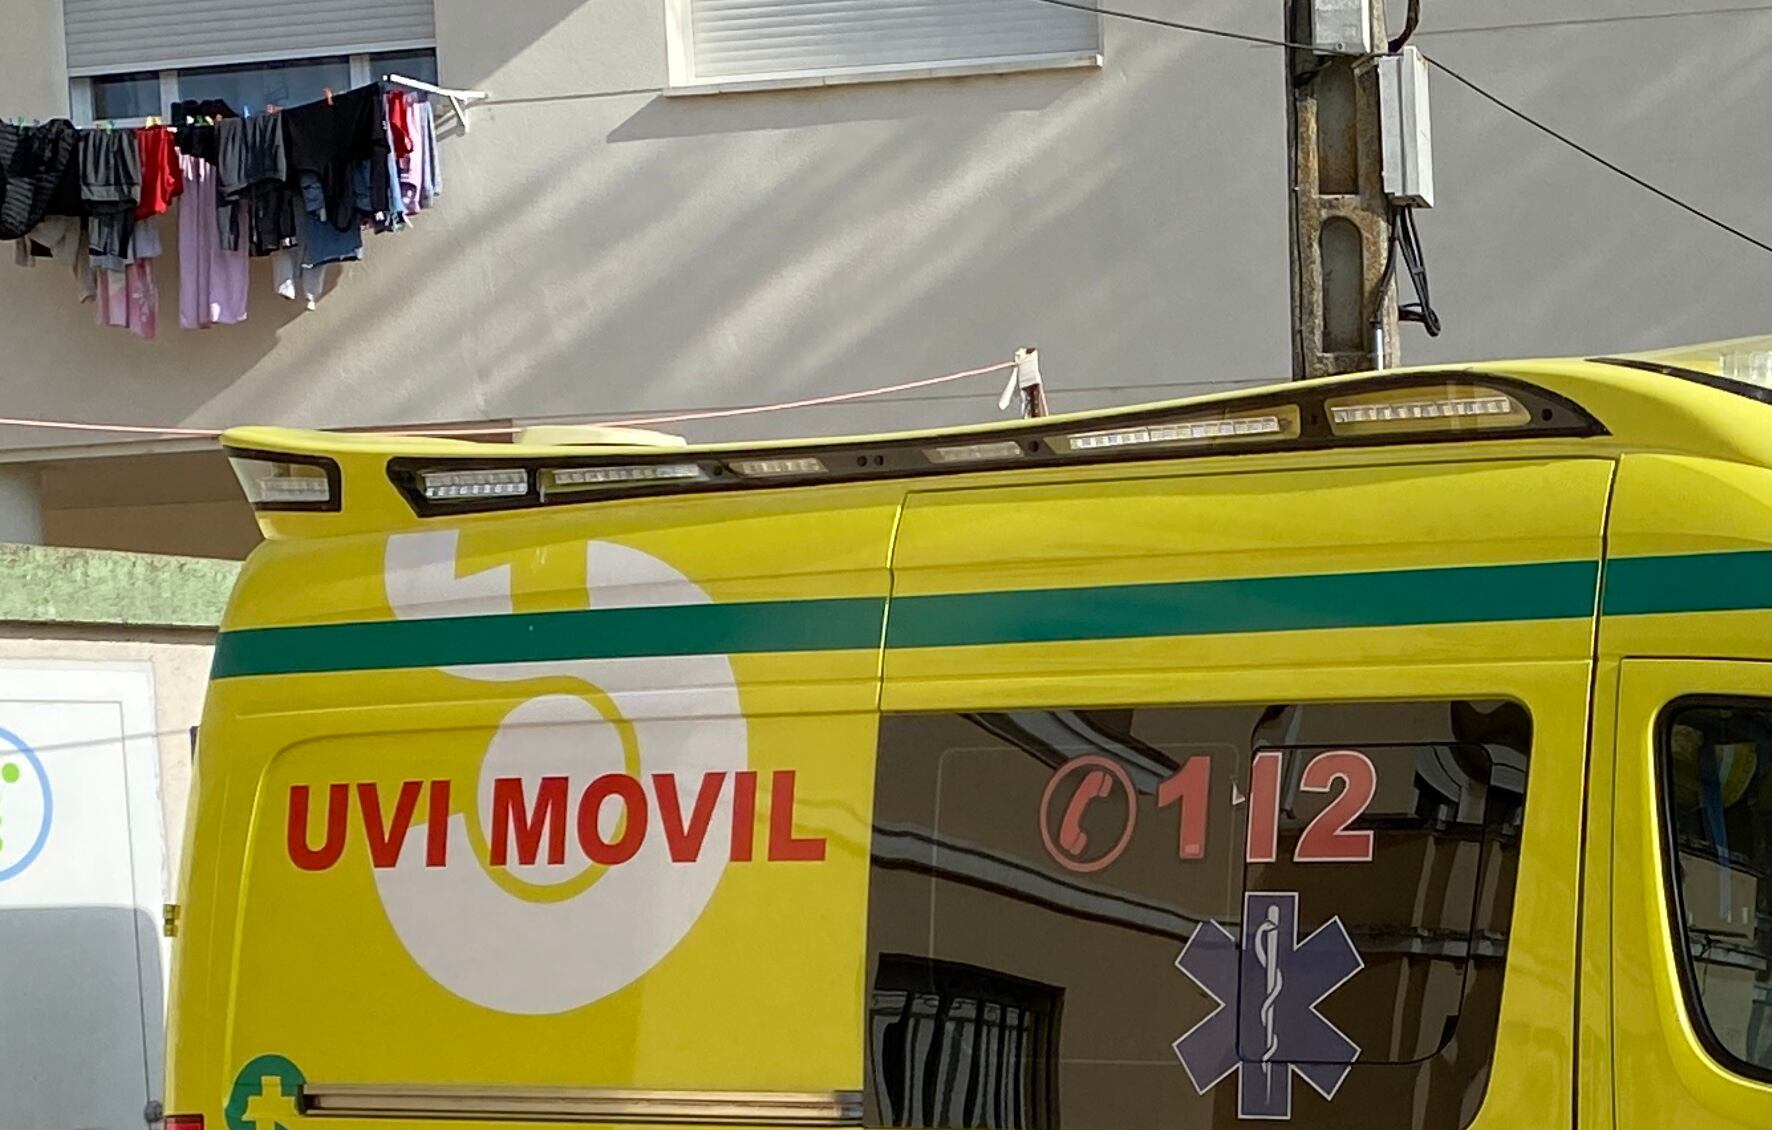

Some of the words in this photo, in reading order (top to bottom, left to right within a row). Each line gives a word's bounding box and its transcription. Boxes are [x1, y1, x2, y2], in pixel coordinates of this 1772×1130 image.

[286, 780, 452, 872] UVI
[488, 769, 828, 867] MOVIL
[1157, 750, 1377, 864] 112
